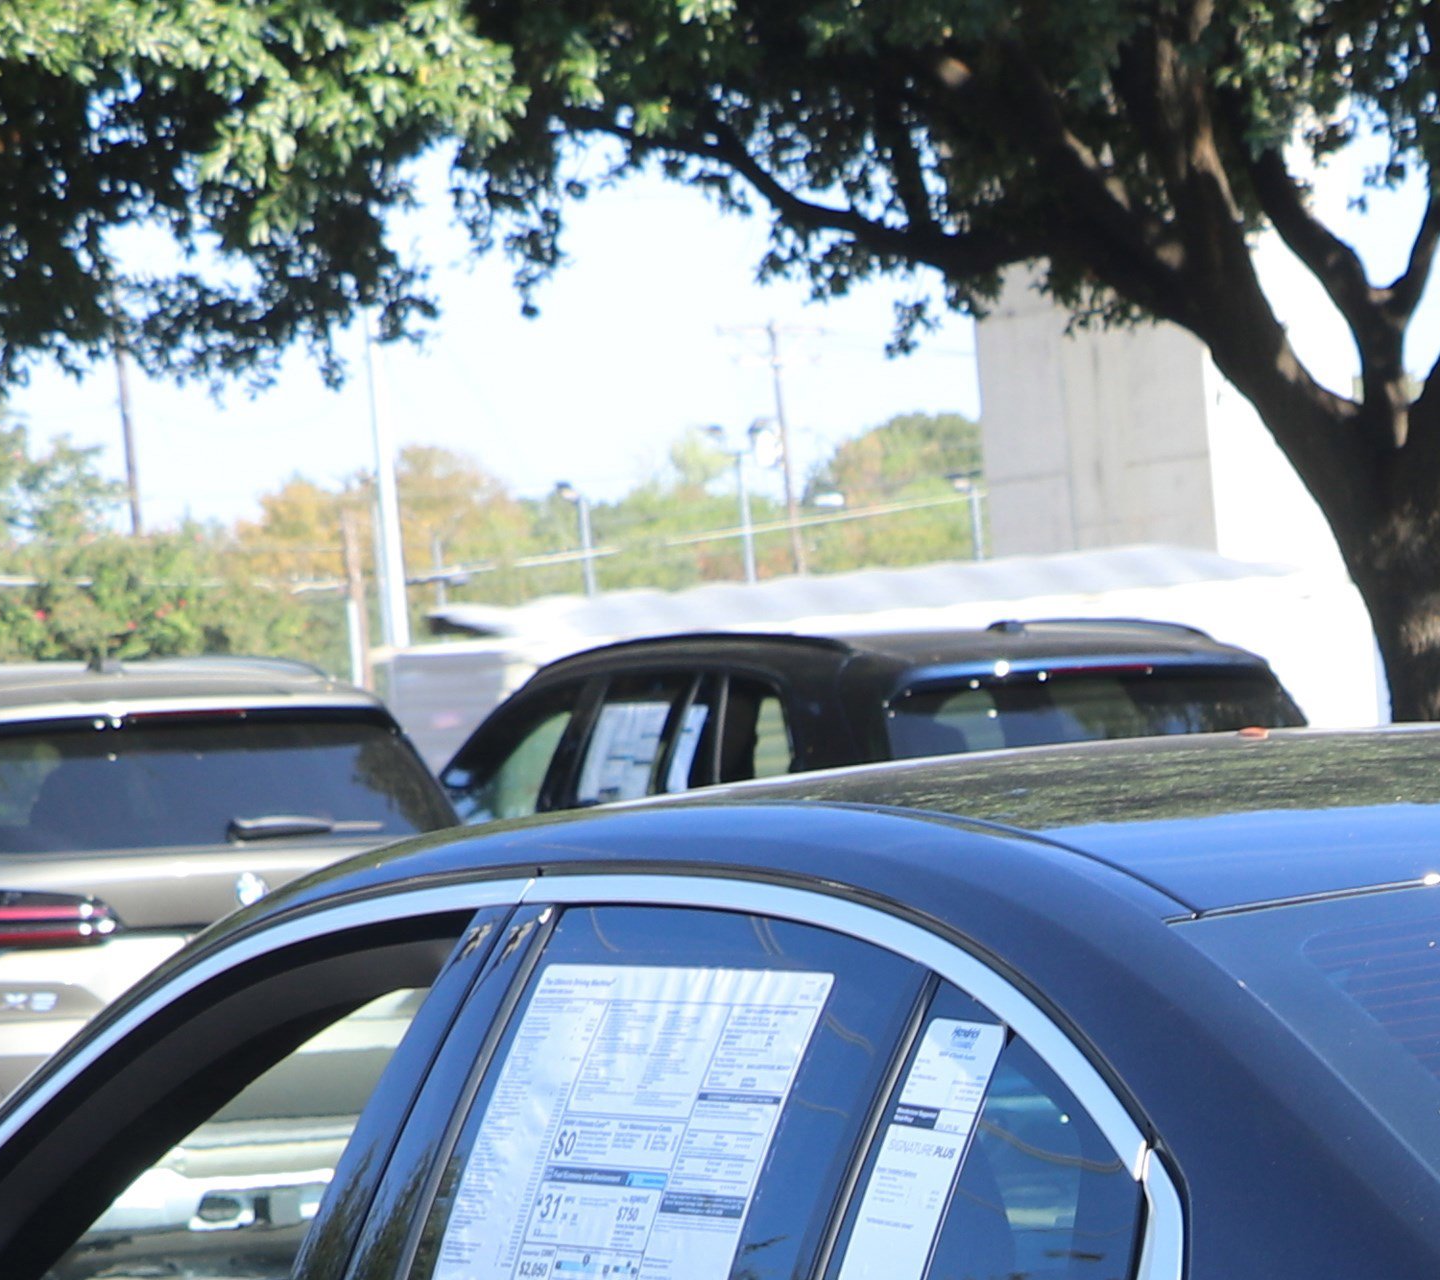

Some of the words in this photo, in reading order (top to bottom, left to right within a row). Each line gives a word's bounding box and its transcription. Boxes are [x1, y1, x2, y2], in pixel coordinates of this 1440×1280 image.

[554, 1128, 577, 1158] $0
[933, 1144, 957, 1160] PLUS
[539, 1193, 563, 1220] 31
[615, 1205, 640, 1223] $750
[518, 1260, 548, 1278] $2,050
